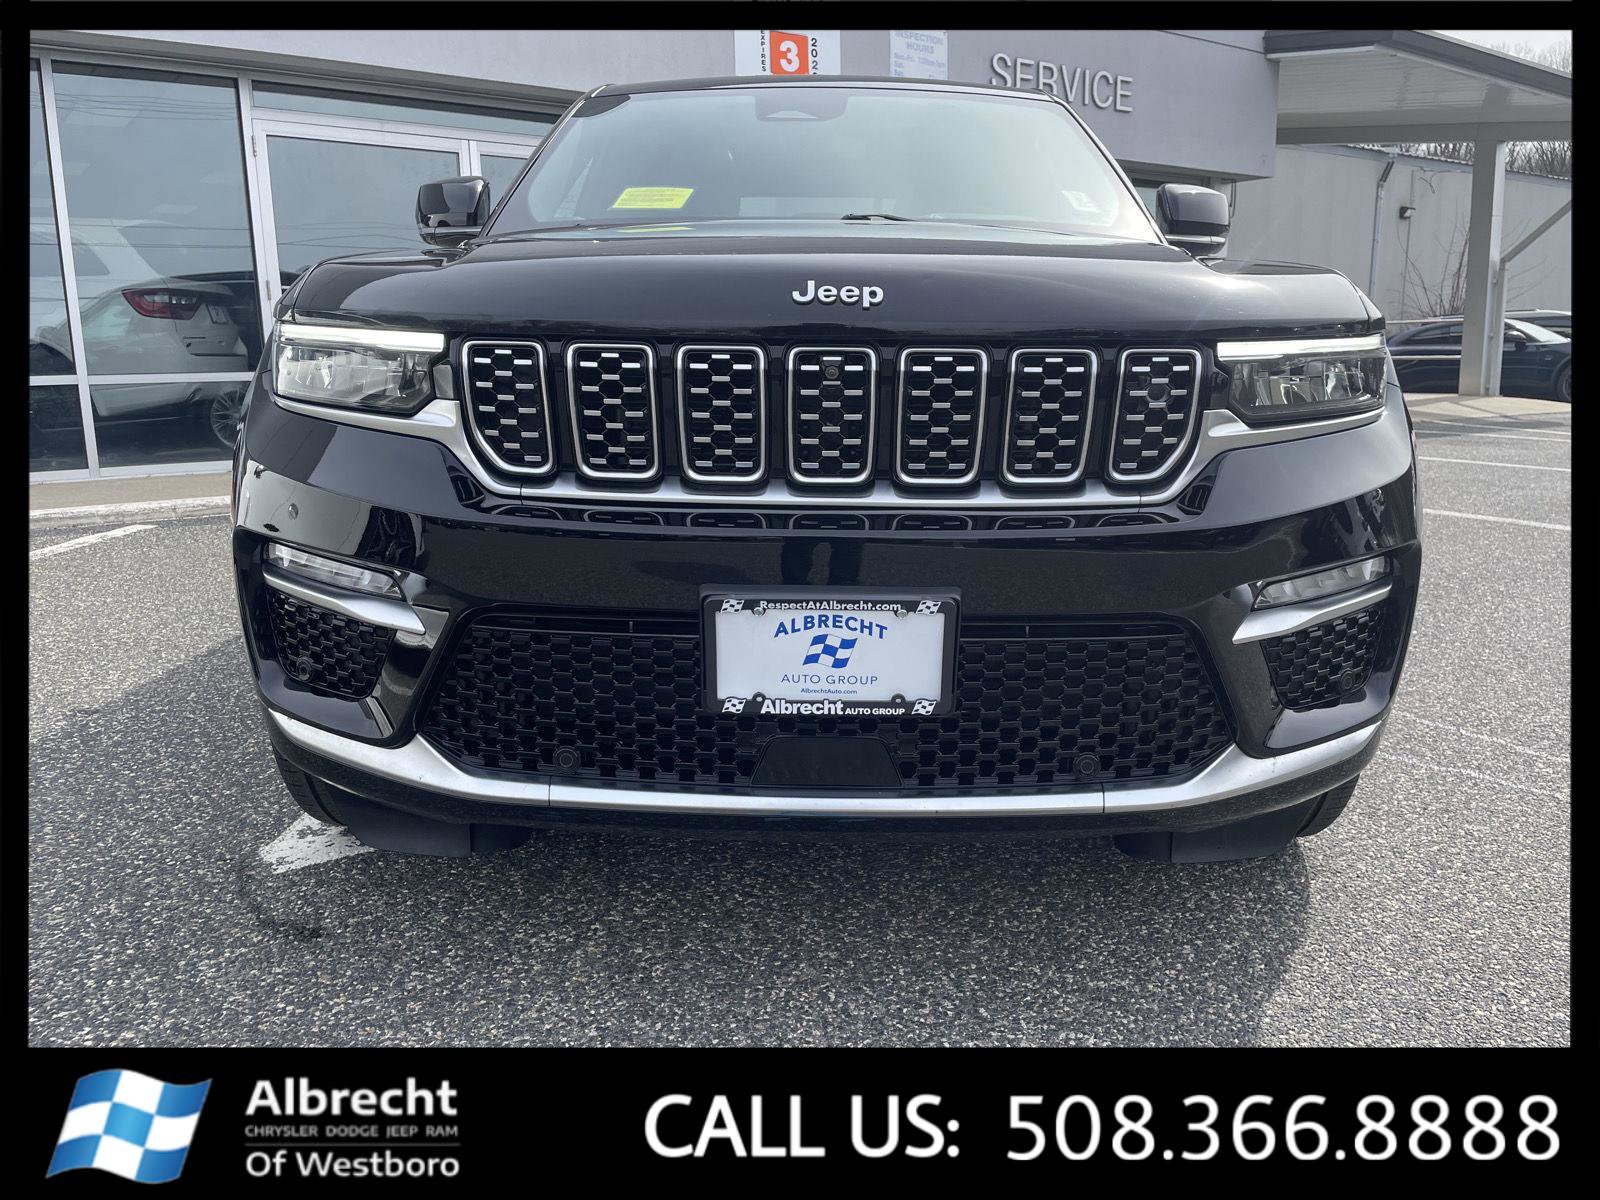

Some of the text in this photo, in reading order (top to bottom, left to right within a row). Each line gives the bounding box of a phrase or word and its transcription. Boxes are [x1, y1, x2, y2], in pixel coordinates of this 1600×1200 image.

[779, 40, 800, 72] 3
[991, 53, 1133, 112] SERVICE
[791, 280, 884, 309] Jeep
[759, 600, 901, 613] RespectAtAlbrecht.com
[774, 614, 888, 639] ALBRECHT
[781, 674, 878, 685] AUTO GROUP
[760, 699, 844, 715] Albrecht
[845, 707, 871, 715] AUTO
